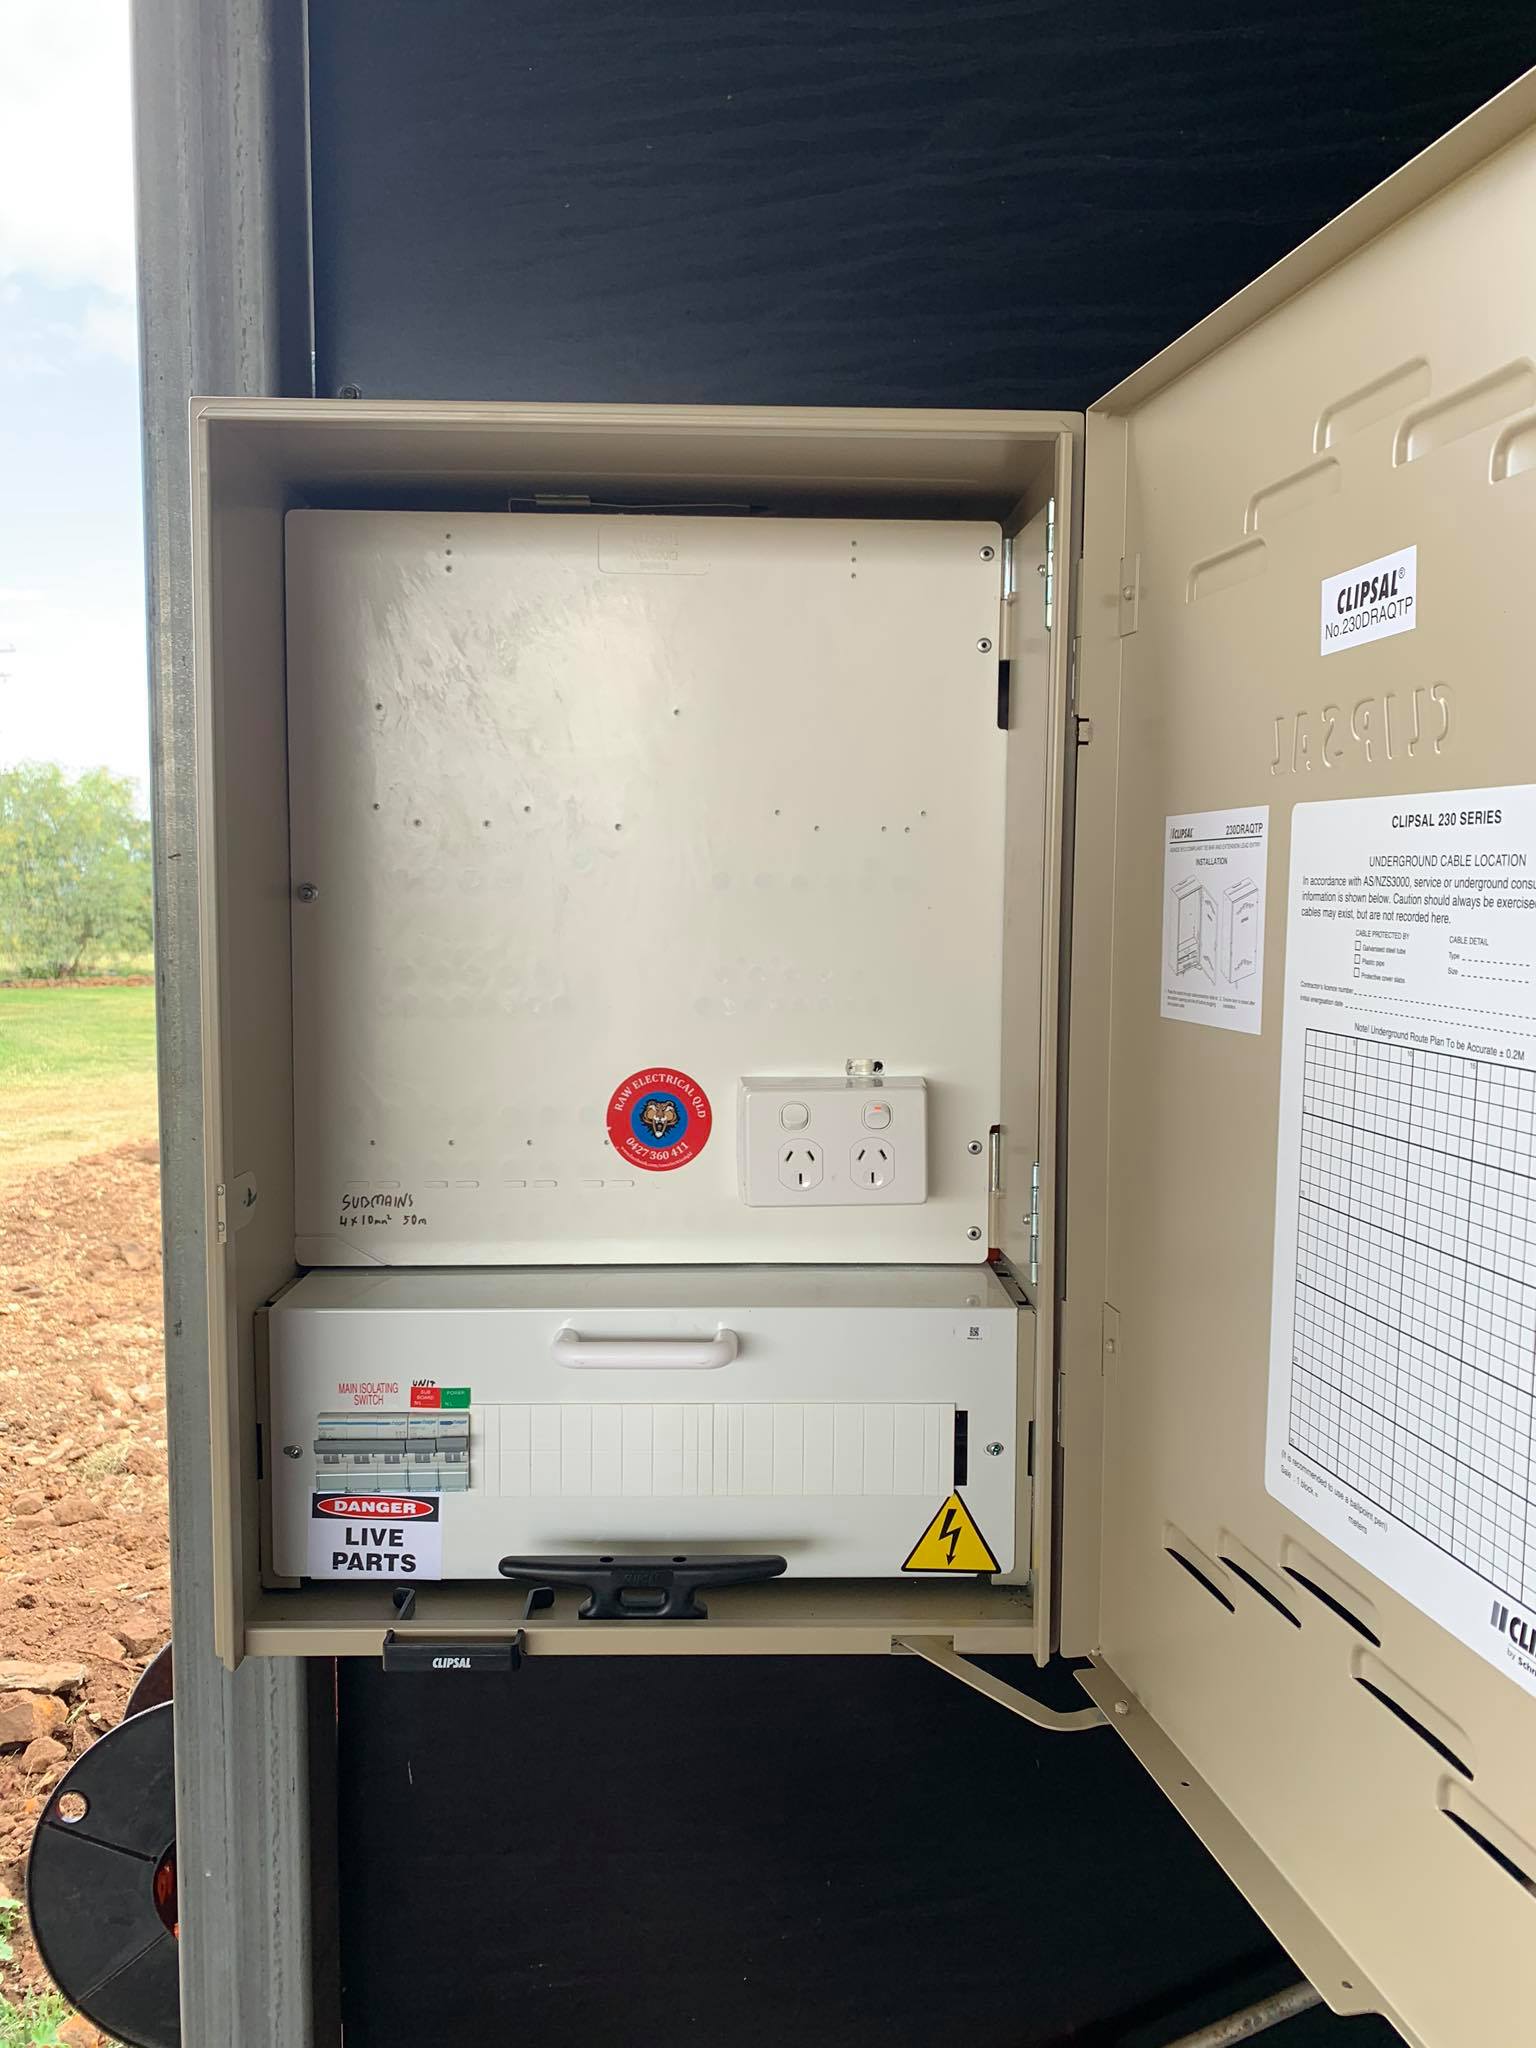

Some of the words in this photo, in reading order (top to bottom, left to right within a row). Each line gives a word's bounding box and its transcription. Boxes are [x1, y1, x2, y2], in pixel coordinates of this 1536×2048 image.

[1325, 596, 1413, 640] No.230DRAQTP
[1391, 813, 1435, 828] CLIPSAL
[1438, 812, 1457, 826] 230
[1459, 809, 1502, 825] SERIES
[1195, 857, 1228, 866] INSTALLATION
[1369, 855, 1438, 867] UNDERGROUND
[1440, 854, 1472, 867] CABLE
[1474, 854, 1527, 867] LOCATION
[1302, 876, 1309, 886] In
[1310, 876, 1347, 886] accordance
[1348, 876, 1362, 886] with
[1414, 877, 1441, 888] service
[1443, 879, 1452, 888] or
[1454, 877, 1509, 891] underground
[1302, 891, 1336, 902] information
[1338, 892, 1344, 902] is
[1345, 892, 1366, 903] shown
[1393, 892, 1422, 904] Caution
[1424, 894, 1450, 906] should
[1452, 895, 1481, 909] always
[1483, 895, 1494, 907] be
[1301, 908, 1321, 917] cables
[1322, 909, 1336, 920] may
[1356, 909, 1368, 919] but
[1369, 911, 1381, 920] are
[1382, 910, 1394, 921] not
[1396, 911, 1429, 923] recorded
[1355, 929, 1371, 938] CABLE
[1372, 930, 1402, 940] PROTECTED
[1403, 932, 1410, 940] BY
[1449, 936, 1467, 944] CABLE
[1469, 937, 1489, 946] DETAIL
[1448, 951, 1460, 960] Type
[1447, 967, 1459, 975] Size
[1370, 1024, 1409, 1041] Underground
[1410, 1032, 1429, 1044] Route
[1430, 1035, 1444, 1047] Plan
[1446, 1037, 1455, 1048] To
[1456, 1039, 1465, 1051] be
[1466, 1042, 1497, 1057] Accurate
[1506, 1048, 1525, 1061] 0.2M
[614, 1086, 632, 1111] RAW
[632, 1073, 695, 1097] ELECTRICAL
[692, 1095, 706, 1119] QLD
[625, 1137, 650, 1157] 0427
[649, 1150, 669, 1160] 360
[671, 1141, 689, 1157] 411
[338, 1383, 358, 1394] MAIN
[359, 1382, 399, 1394] ISOLATING
[412, 1379, 436, 1388] UNIT
[353, 1394, 384, 1406] SWITCH
[334, 1500, 417, 1514] DANGER
[345, 1527, 404, 1547] LIVE
[332, 1552, 417, 1573] PARTS
[432, 1657, 472, 1669] CLIPSAL
